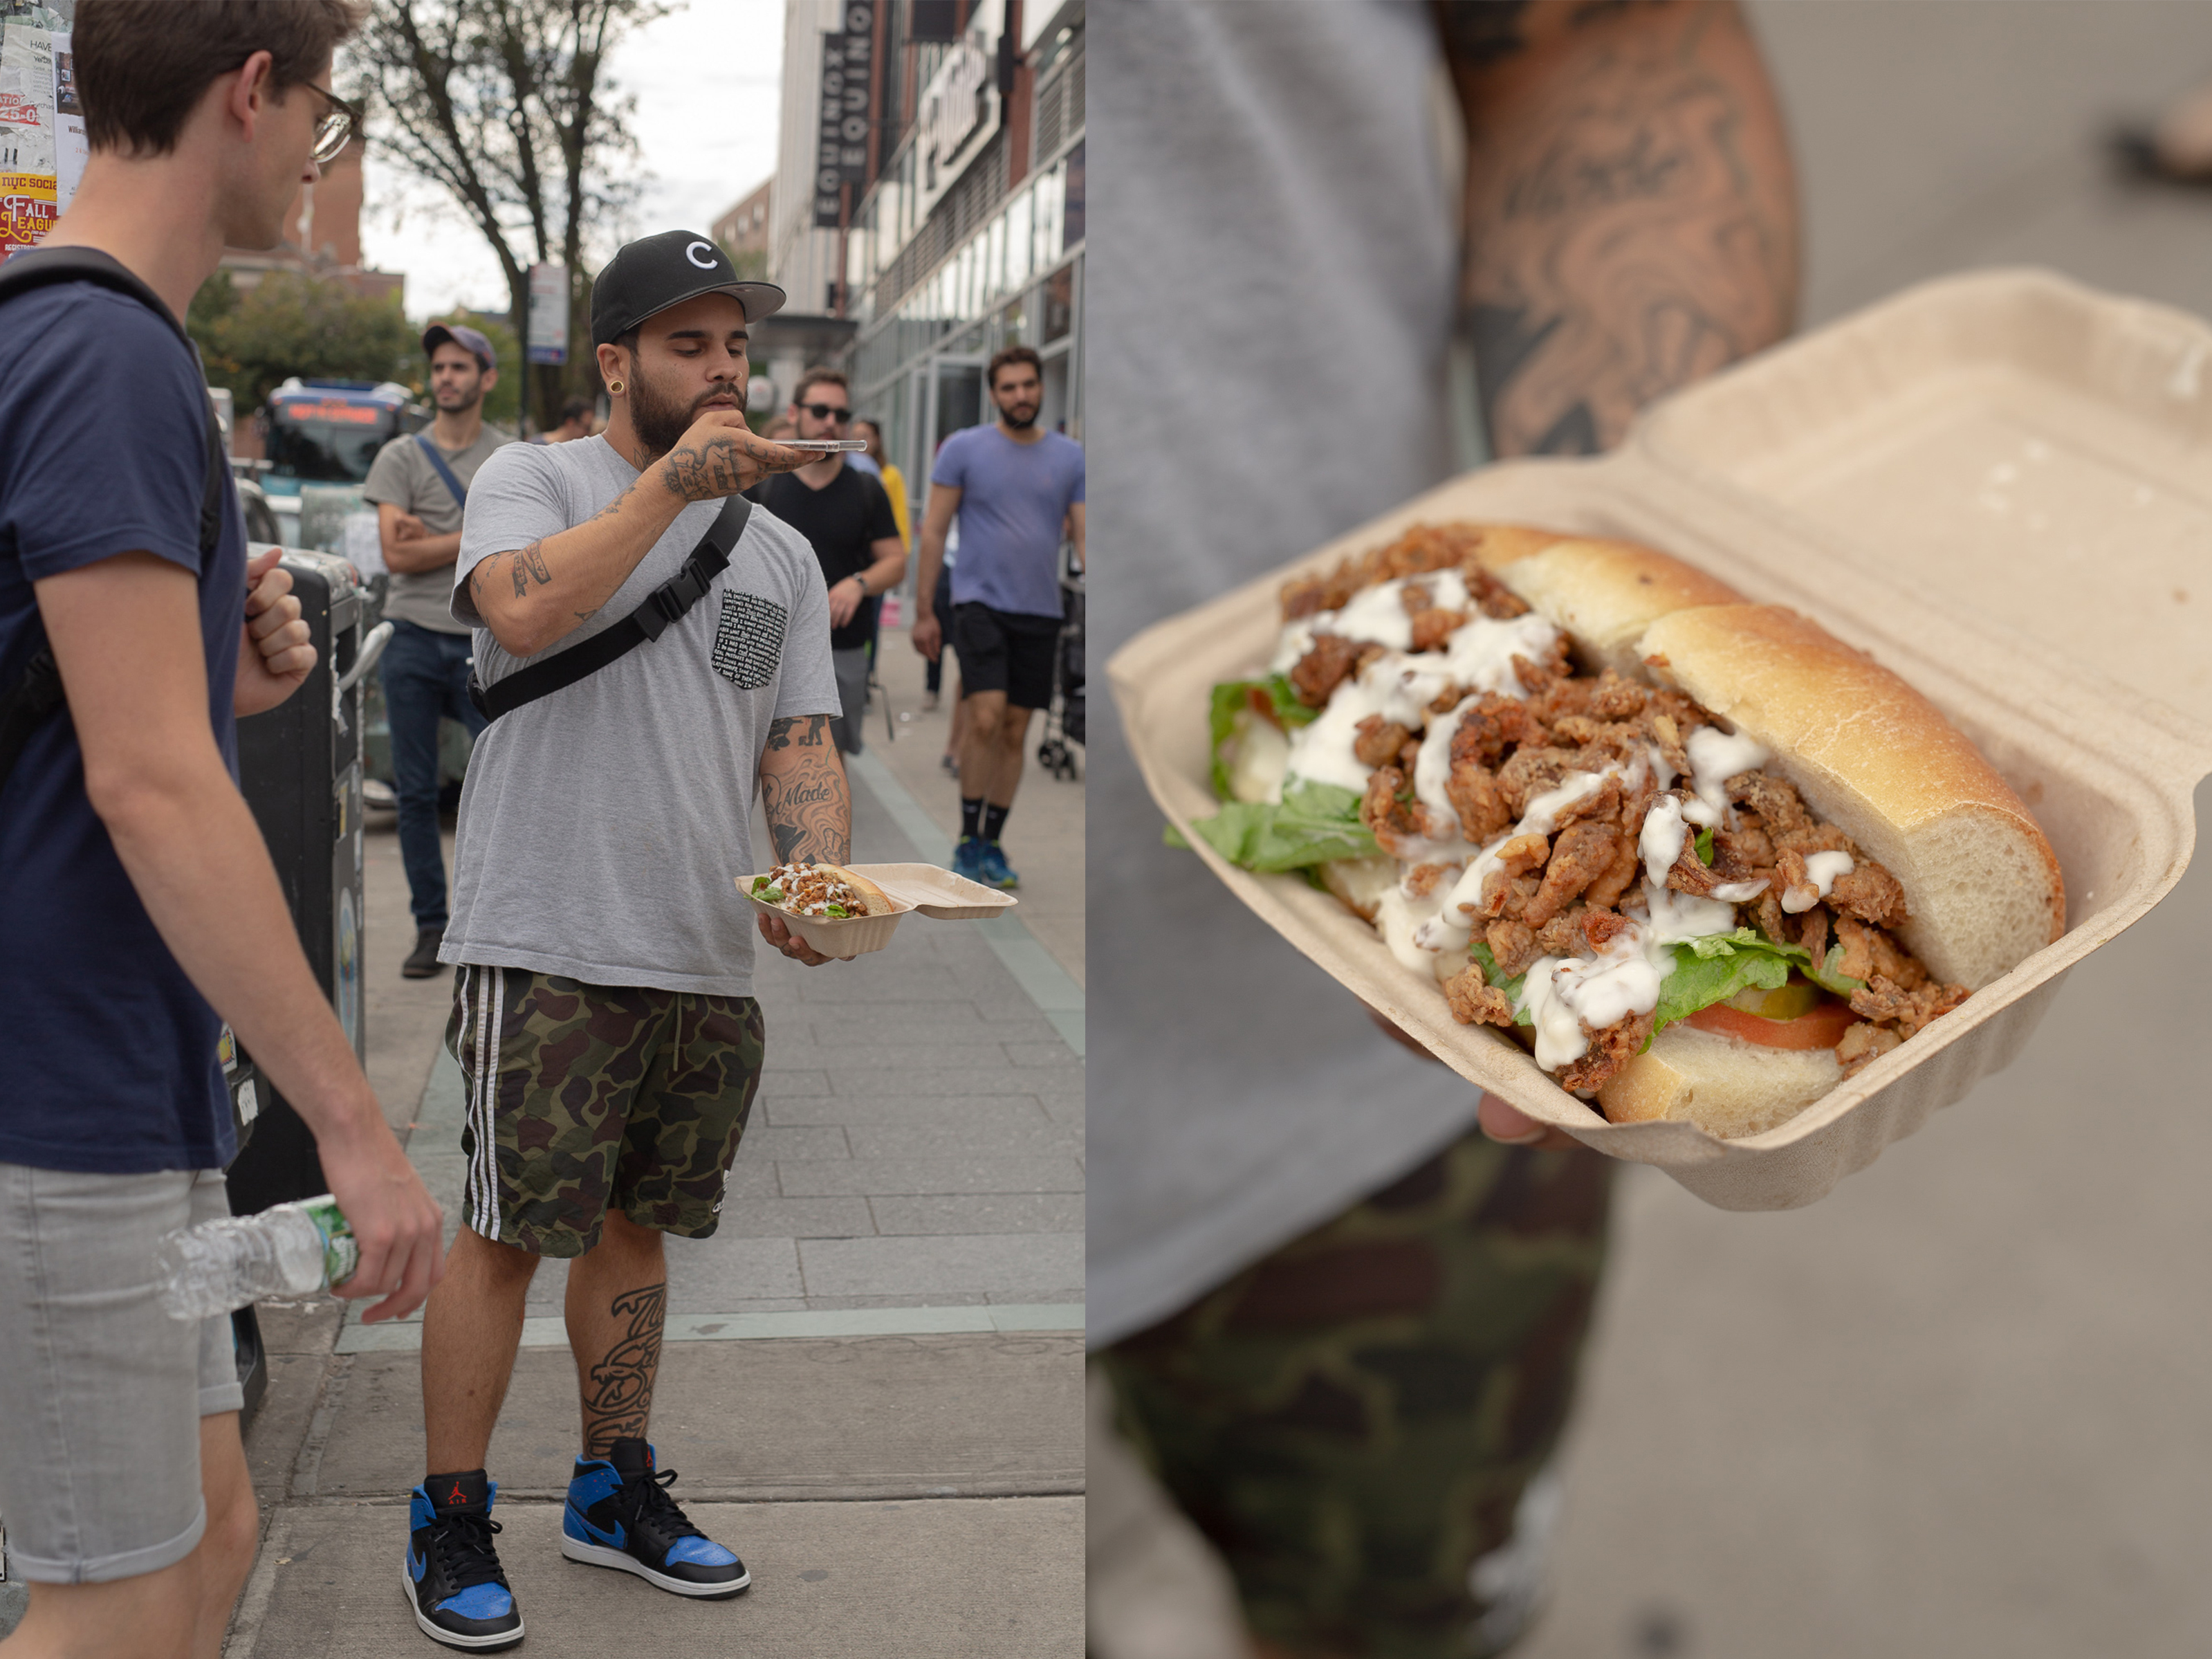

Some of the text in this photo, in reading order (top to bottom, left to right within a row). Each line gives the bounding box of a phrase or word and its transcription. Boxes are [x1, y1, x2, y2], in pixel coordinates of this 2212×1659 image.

[30, 40, 52, 52] HAVE
[815, 48, 845, 214] EQUINOX
[686, 241, 718, 269] C
[777, 781, 830, 815] Made
